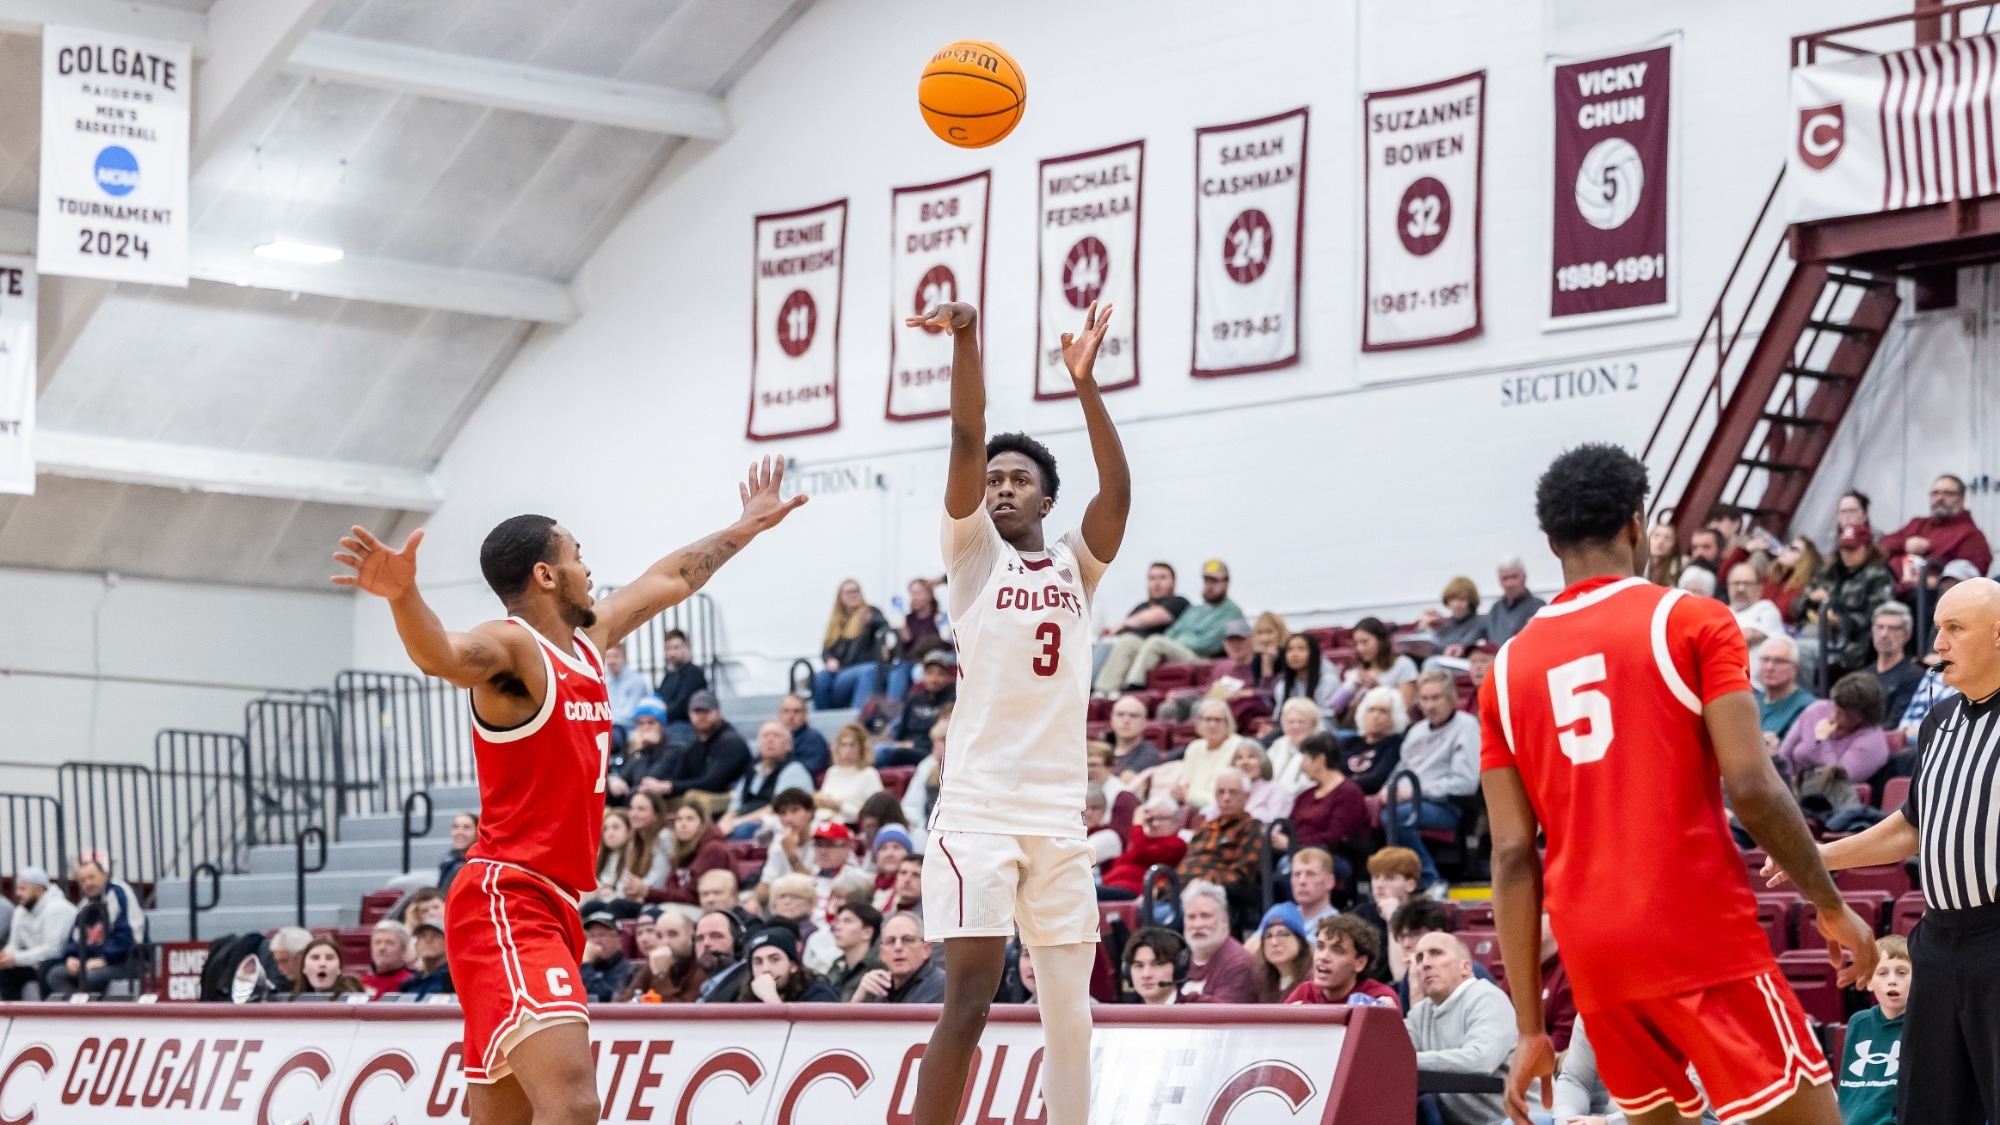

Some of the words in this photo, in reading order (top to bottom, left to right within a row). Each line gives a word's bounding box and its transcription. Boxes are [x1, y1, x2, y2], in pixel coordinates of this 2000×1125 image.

[58, 45, 176, 91] COLGATE
[932, 49, 999, 74] Wilson
[1577, 61, 1649, 98] VICKY
[1374, 96, 1476, 132] SUZANNE
[1578, 96, 1647, 130] CHUN
[1220, 137, 1283, 165] SARAH
[1385, 135, 1464, 166] BOWEN
[1802, 113, 1841, 157] C
[1049, 164, 1131, 195] MICHAEL
[1201, 162, 1295, 197] CASHMAN
[1602, 165, 1618, 202] 5
[57, 196, 172, 225] TOURNAMENT
[920, 198, 959, 222] BOB
[1046, 196, 1131, 229] FERRARA
[1407, 194, 1441, 238] 32
[80, 228, 149, 260] 2024
[774, 221, 824, 250] ERNIE
[906, 223, 972, 254] DUFFY
[1232, 226, 1266, 268] 24
[787, 303, 810, 342] 11
[1500, 365, 1619, 408] SECTION
[1625, 362, 1639, 391] 2
[776, 467, 859, 499] ECTION
[1032, 622, 1062, 677] 3
[1546, 652, 1615, 766] 5
[545, 967, 573, 997] C
[61, 1037, 264, 1111] COLGATE
